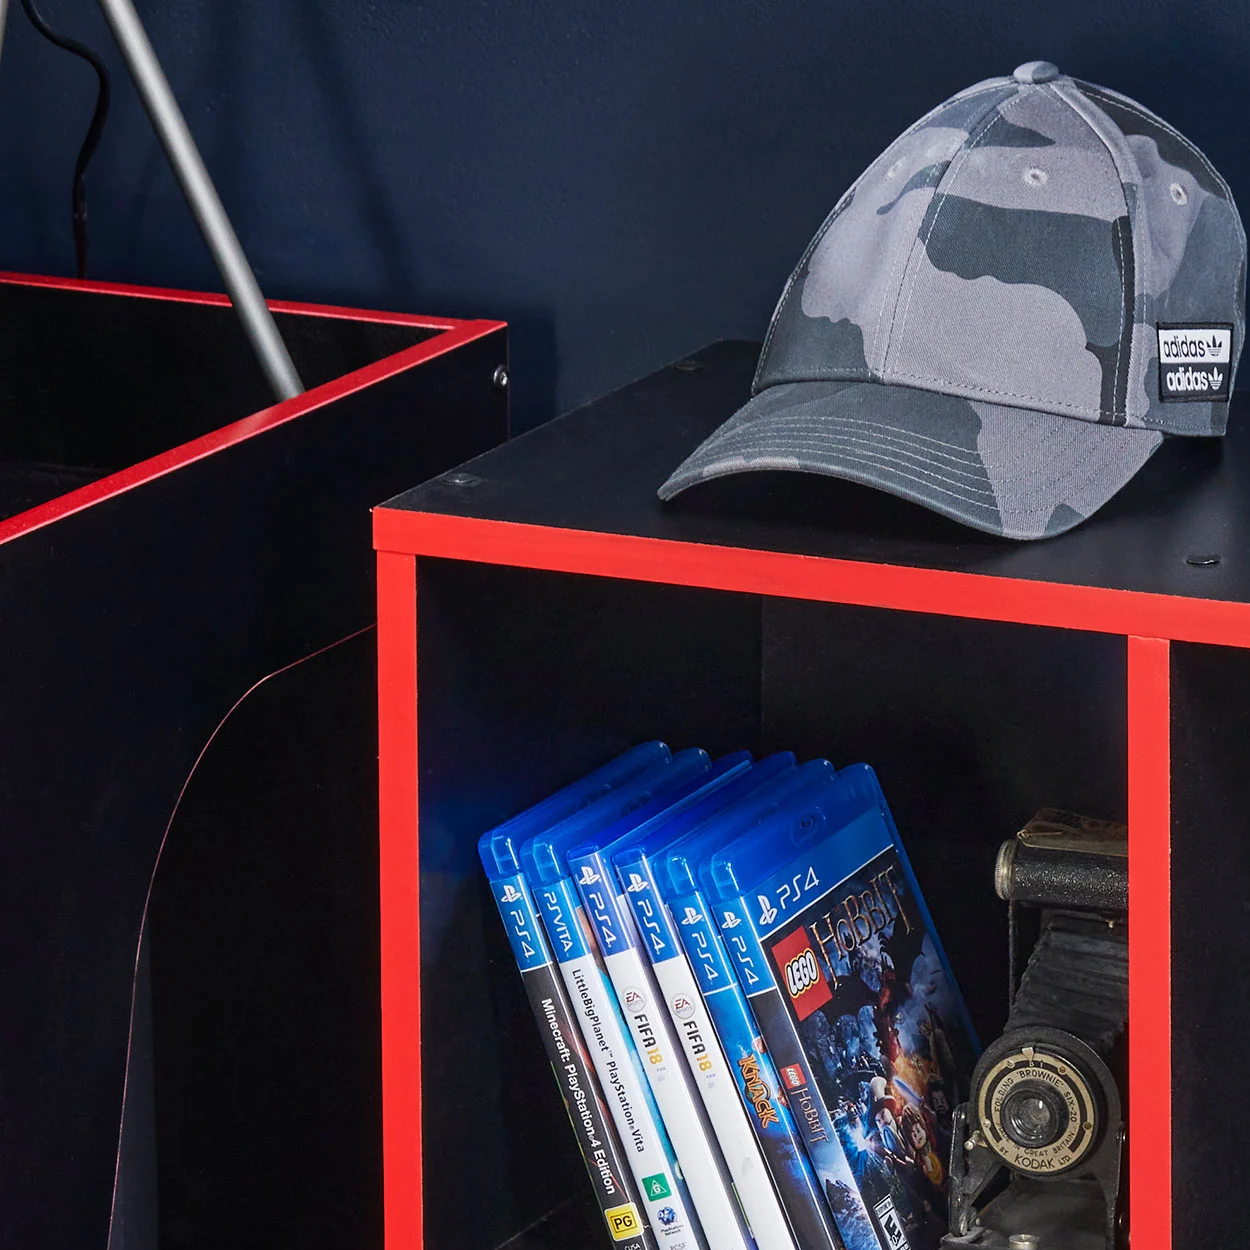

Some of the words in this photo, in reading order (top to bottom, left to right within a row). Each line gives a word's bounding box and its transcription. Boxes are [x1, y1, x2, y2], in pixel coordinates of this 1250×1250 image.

[1163, 335, 1206, 358] adidas
[1166, 366, 1209, 391] adidas
[776, 866, 820, 910] PS4
[510, 908, 536, 959] PS4
[589, 891, 617, 947] PS4
[637, 898, 666, 953] PS4
[692, 931, 719, 981] PS4
[731, 935, 760, 986] PS4
[785, 948, 819, 998] LEGO
[541, 998, 571, 1062] Minecraft:
[593, 1149, 616, 1195] Edition
[737, 1052, 780, 1129] KNACK
[786, 1067, 801, 1087] LEGO
[994, 1077, 1014, 1112] FOLDING
[1063, 1091, 1078, 1123] SIX-20
[632, 1128, 645, 1152] Vita
[1014, 1153, 1055, 1169] KODAK
[1024, 1149, 1048, 1157] GREAT
[1052, 1131, 1075, 1154] BRITAIN
[614, 1215, 633, 1230] PG
